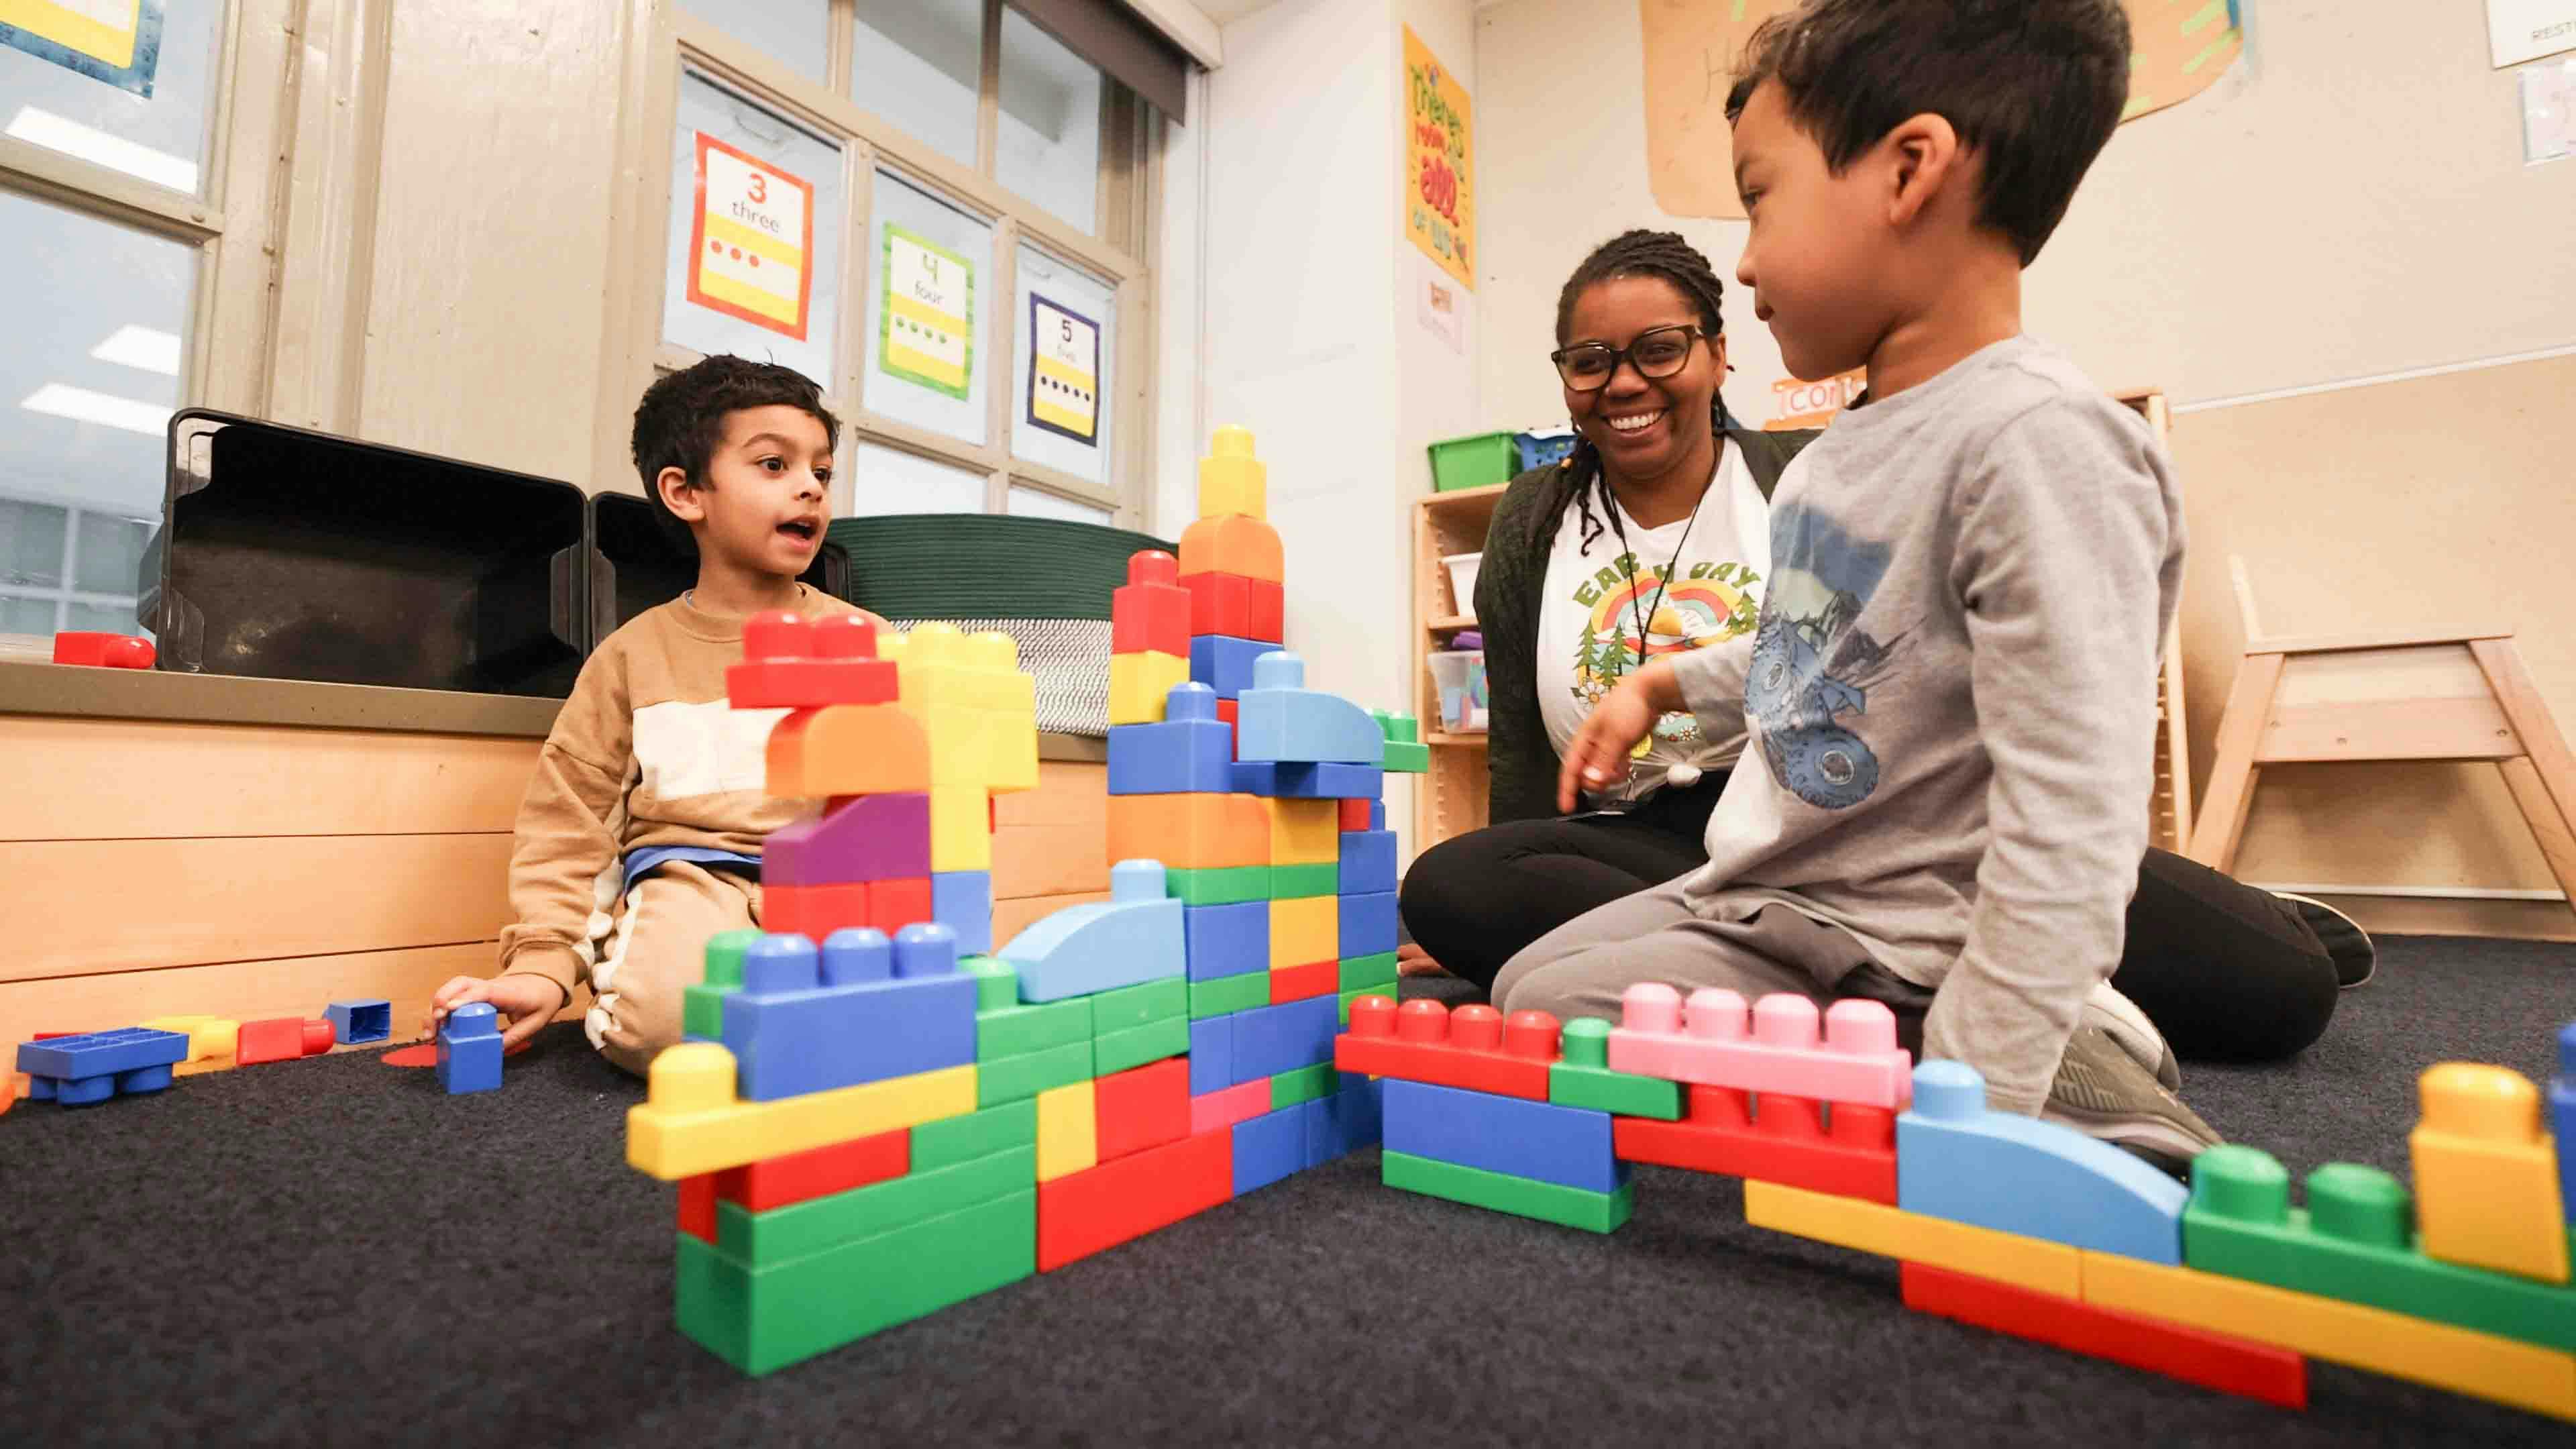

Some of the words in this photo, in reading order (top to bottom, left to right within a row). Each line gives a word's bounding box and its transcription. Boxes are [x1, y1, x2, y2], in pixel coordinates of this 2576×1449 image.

[747, 172, 767, 205] 3
[732, 201, 780, 233] three
[922, 252, 938, 284] 4
[914, 280, 944, 306] four
[1061, 319, 1073, 343] 5
[1689, 561, 1762, 589] DAY
